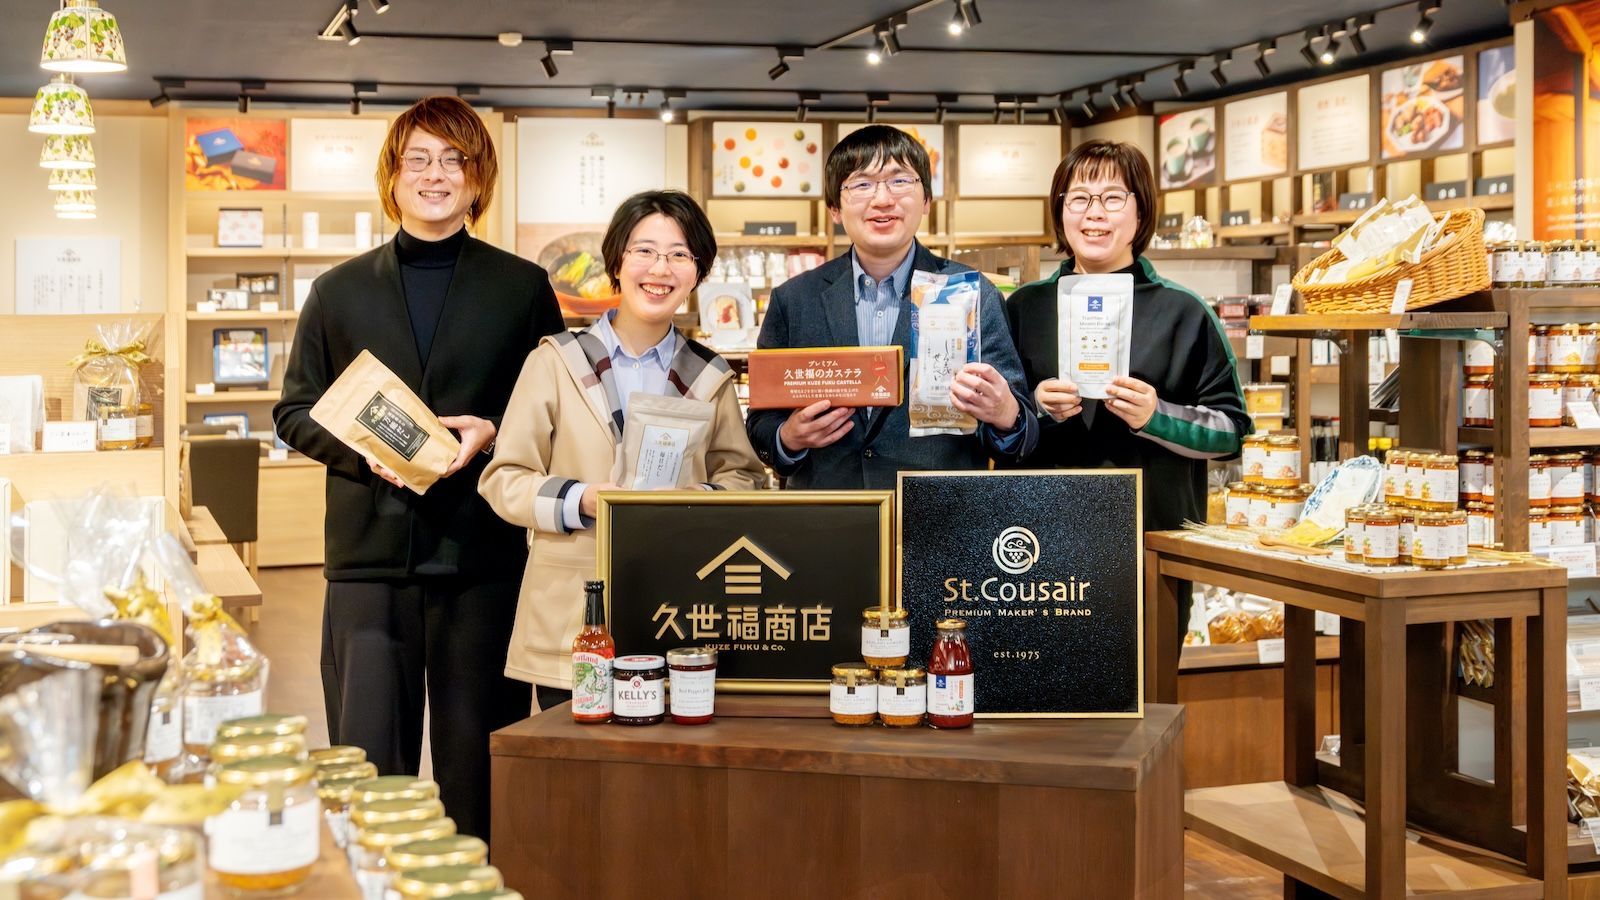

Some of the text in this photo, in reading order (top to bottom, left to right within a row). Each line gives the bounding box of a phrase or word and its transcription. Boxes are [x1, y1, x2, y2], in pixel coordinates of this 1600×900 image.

[784, 368, 862, 380] 久世福のカステラ
[943, 576, 1091, 603] St.Cousair
[944, 608, 991, 617] PREMIUM
[1055, 608, 1092, 617] BRAND
[652, 603, 833, 641] 久世福商店
[704, 643, 731, 652] KUZE
[733, 643, 760, 651] FUKU
[762, 643, 770, 651] &
[993, 650, 1040, 660] est.1975
[618, 690, 657, 700] KELLY'S
